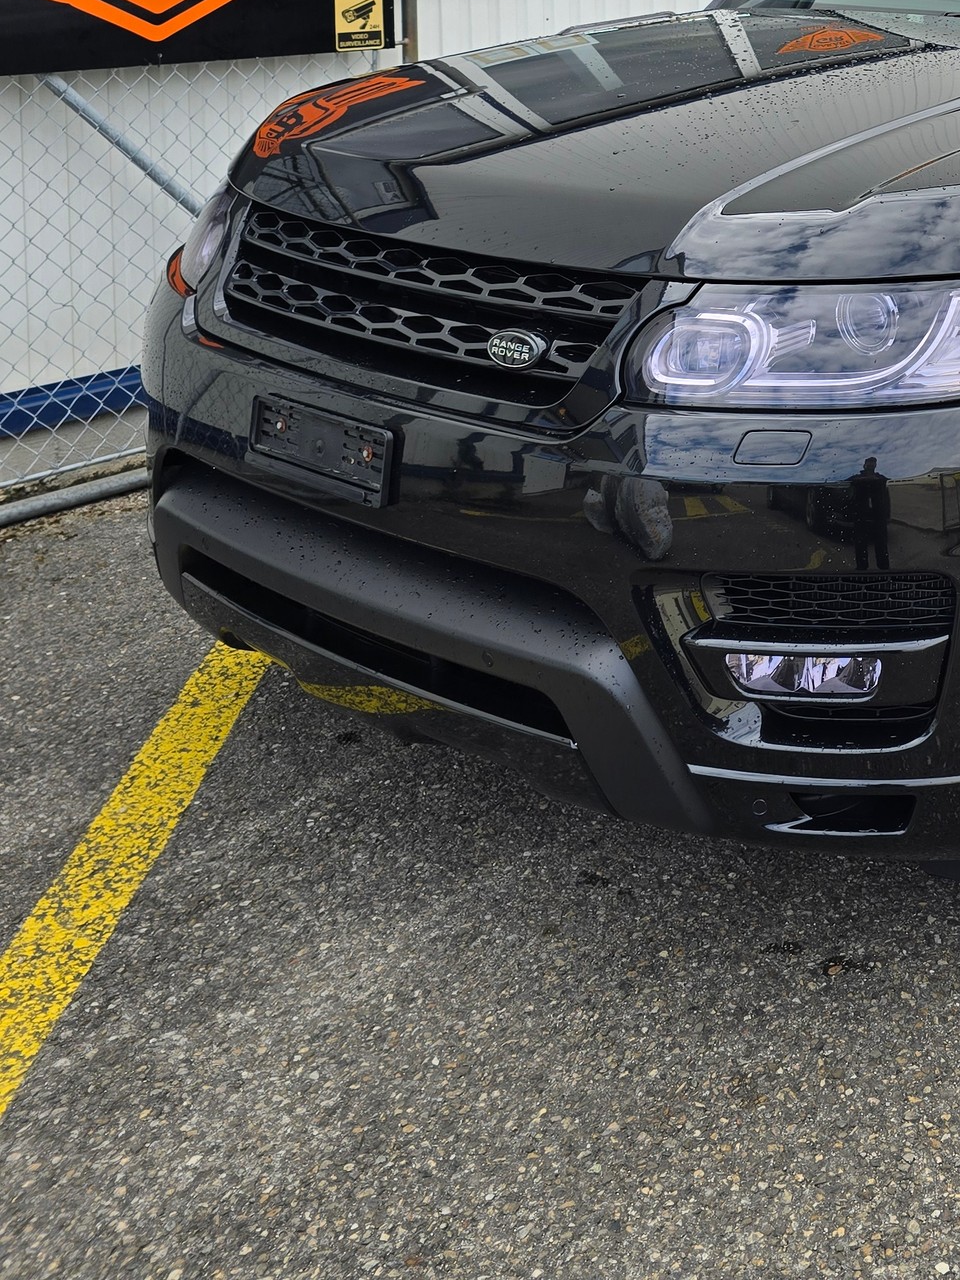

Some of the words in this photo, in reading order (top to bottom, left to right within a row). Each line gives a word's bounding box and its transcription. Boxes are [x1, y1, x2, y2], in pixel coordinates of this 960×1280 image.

[340, 39, 381, 47] SURVEILLANCE
[492, 338, 530, 353] RANGE
[491, 346, 529, 361] ROVER
